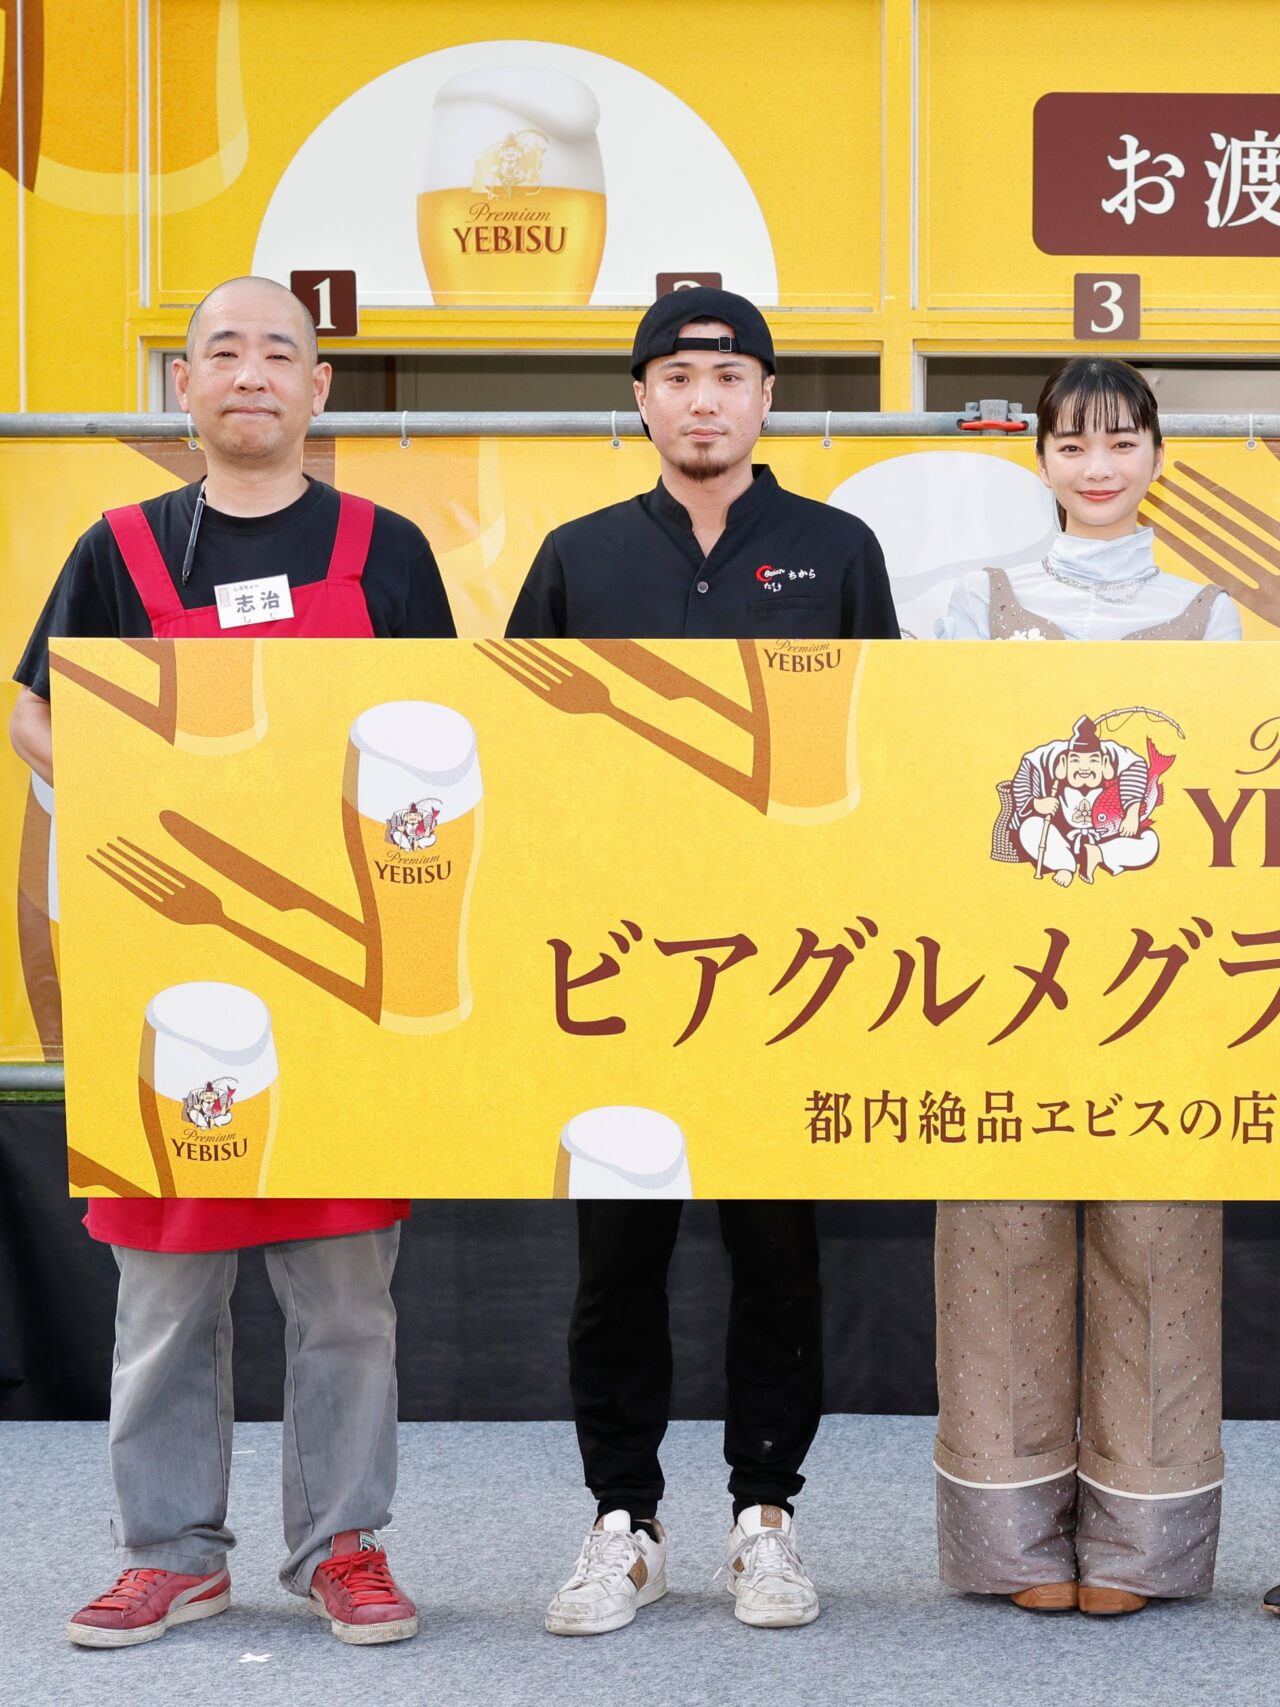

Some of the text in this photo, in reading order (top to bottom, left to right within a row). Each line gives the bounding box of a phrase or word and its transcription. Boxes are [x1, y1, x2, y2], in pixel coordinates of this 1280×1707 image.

[465, 202, 551, 223] Premium
[453, 225, 567, 253] YEBISU
[312, 277, 337, 329] 1
[1091, 280, 1124, 333] 3
[234, 590, 280, 613] 志治
[773, 639, 830, 652] Premium
[763, 648, 841, 672] YEBISU
[384, 850, 440, 864] Premium
[374, 860, 452, 884] YEBISU
[181, 1128, 237, 1143] Premium
[171, 1137, 248, 1161] YEBISU
